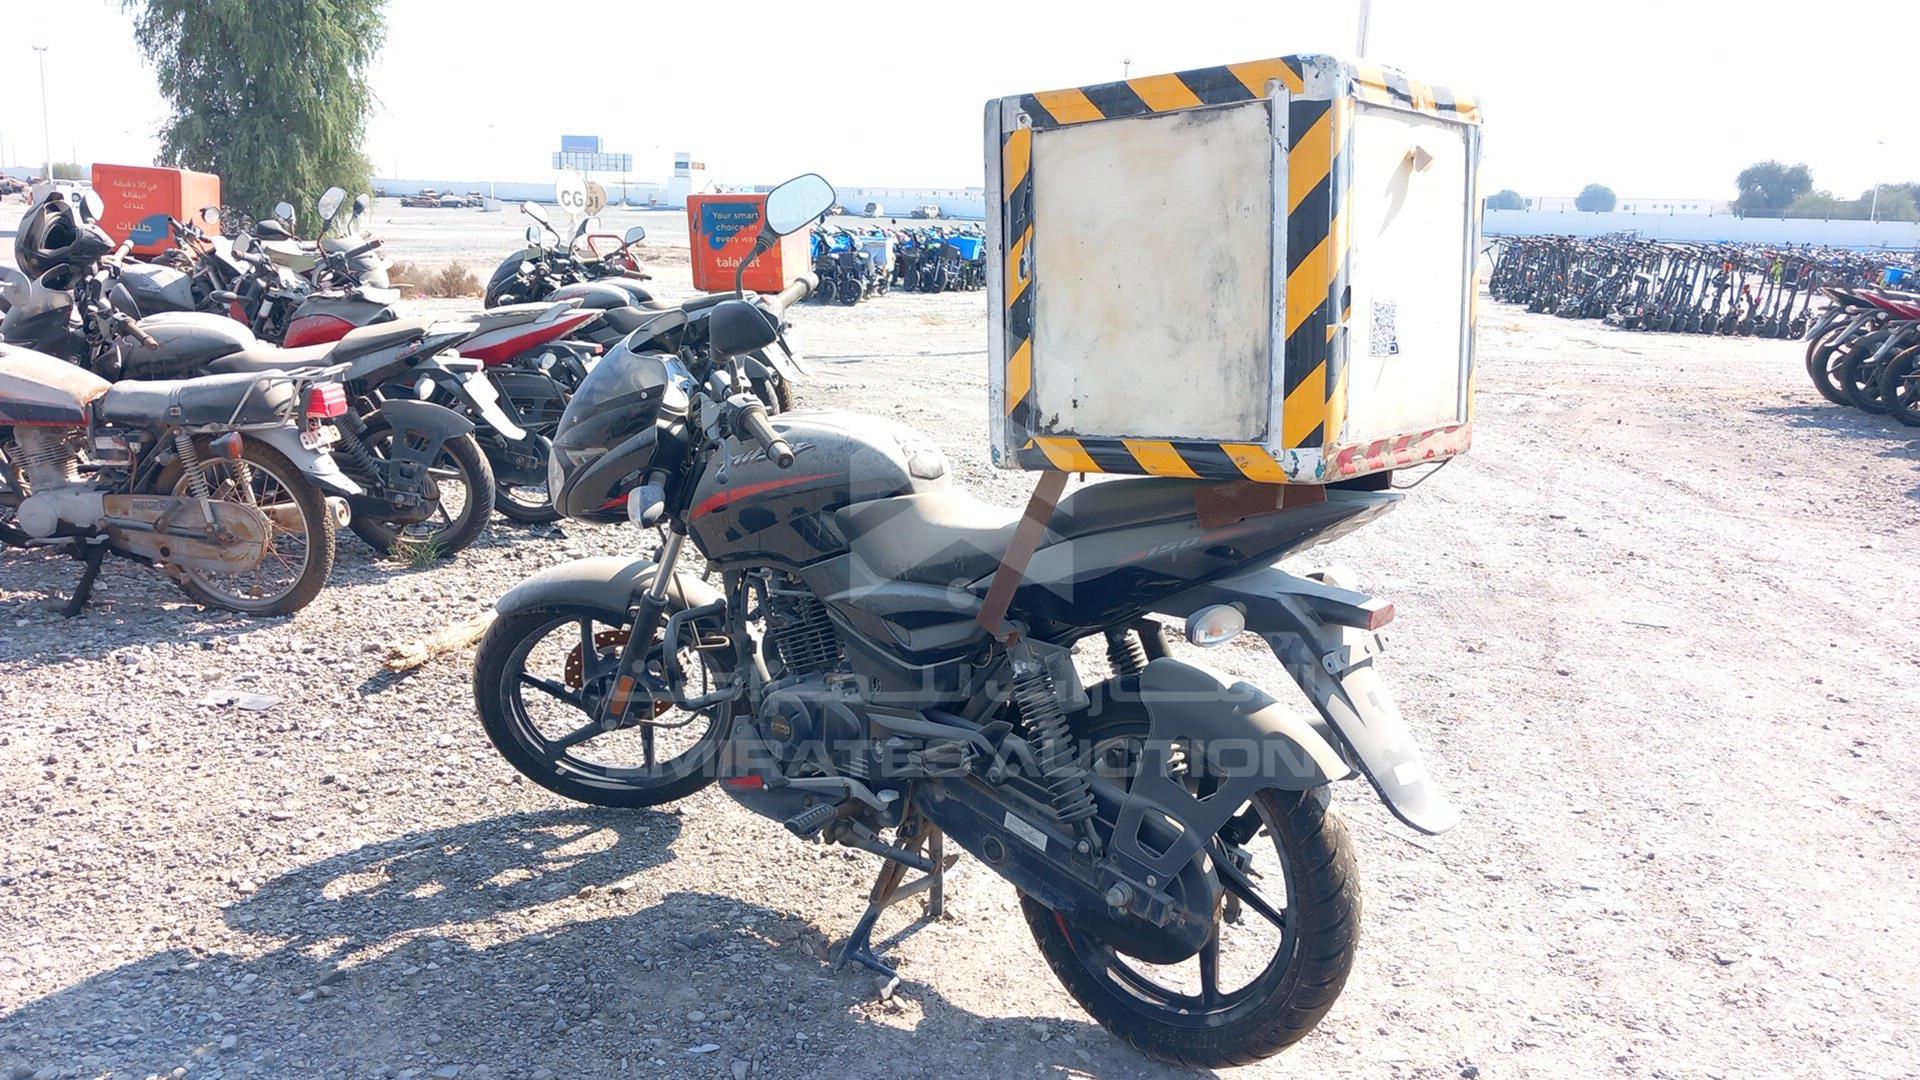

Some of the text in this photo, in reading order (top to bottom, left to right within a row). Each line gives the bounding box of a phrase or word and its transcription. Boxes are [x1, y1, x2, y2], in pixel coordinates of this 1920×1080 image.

[561, 190, 584, 207] CG
[712, 211, 733, 219] Your
[116, 221, 152, 233] طلبات
[716, 223, 745, 231] choice
[715, 236, 738, 244] every
[1147, 537, 1201, 557] 150
